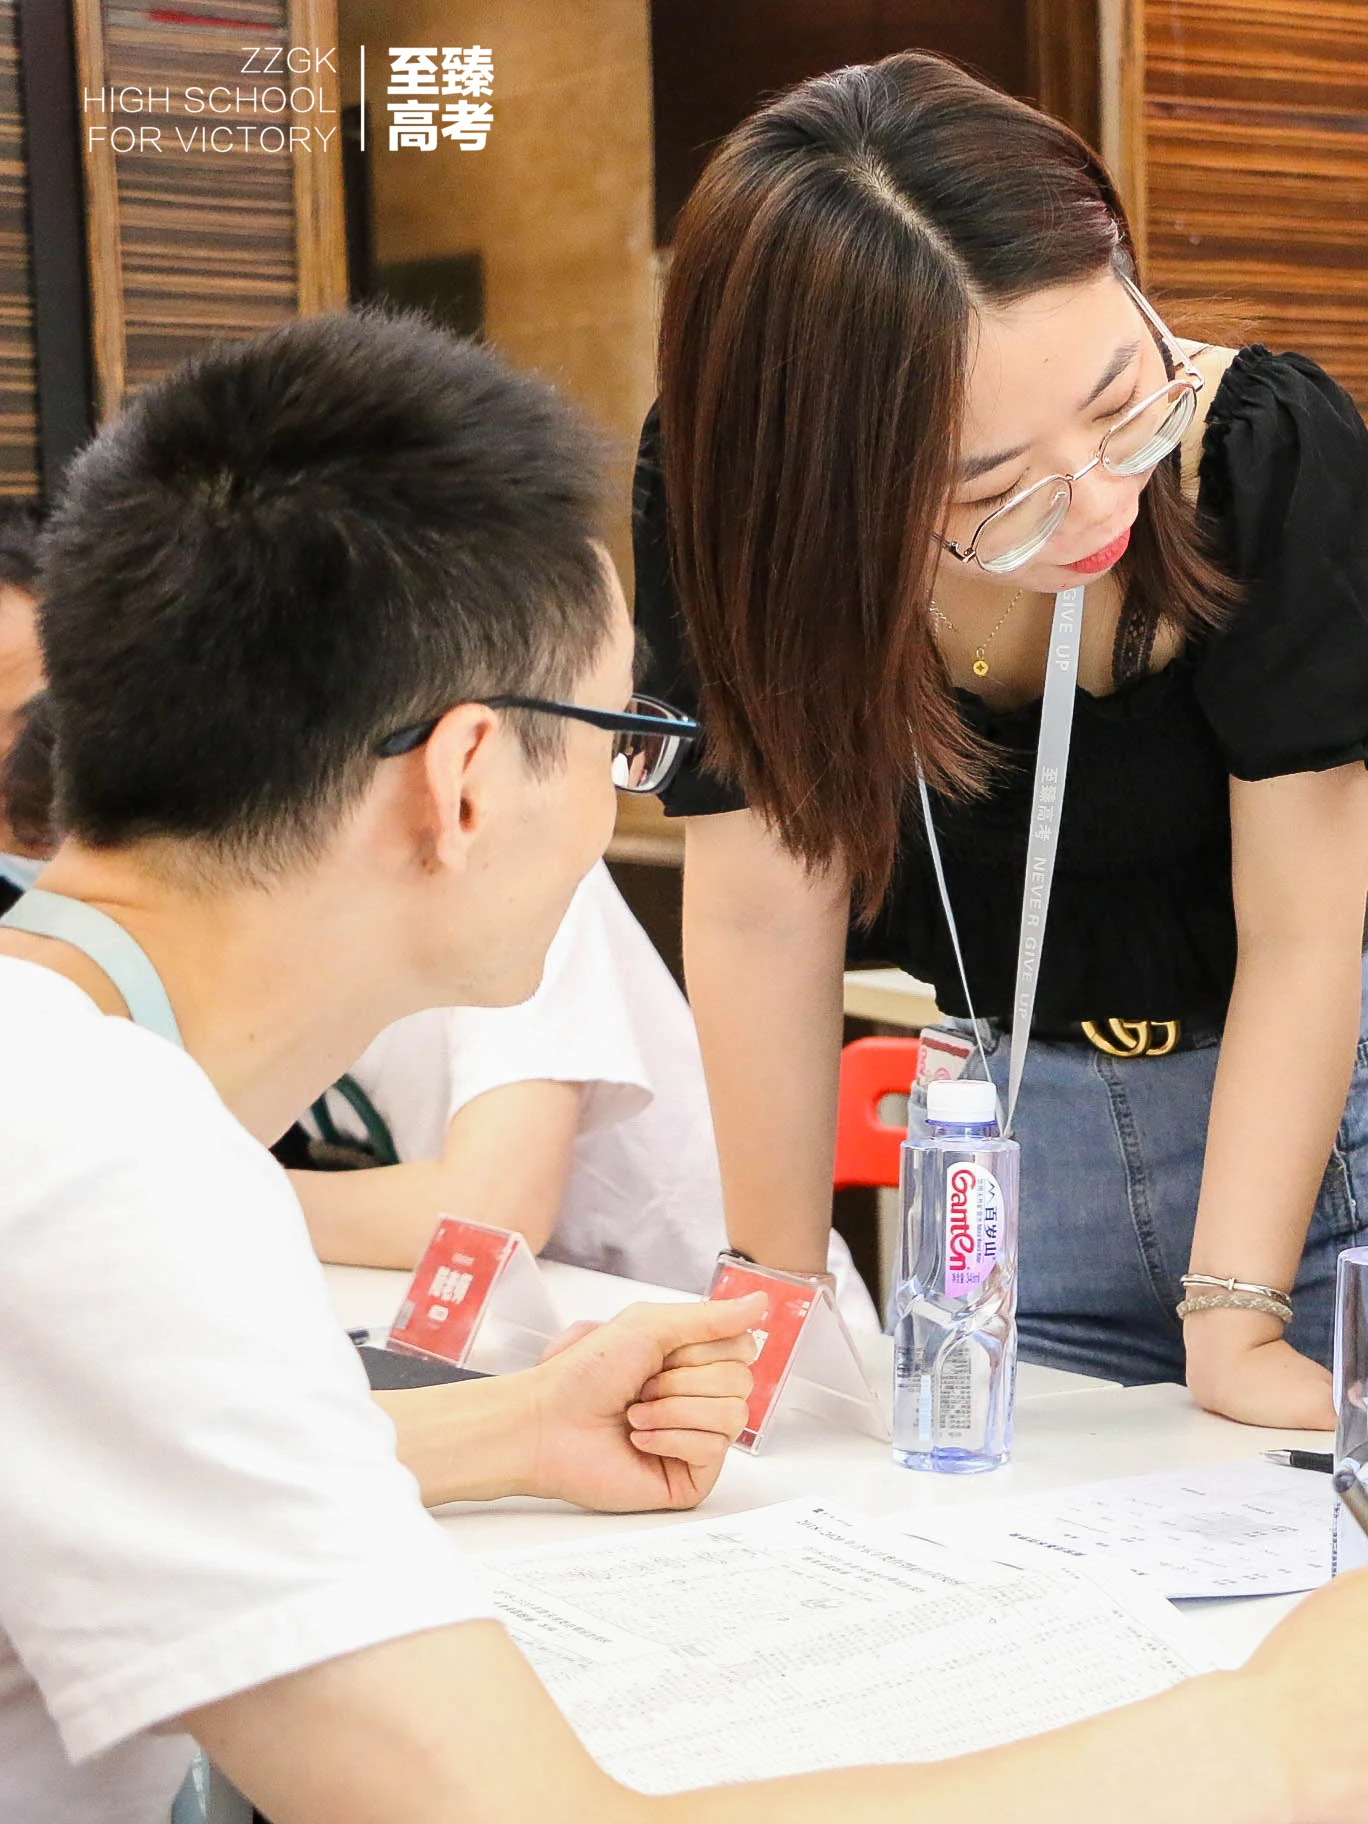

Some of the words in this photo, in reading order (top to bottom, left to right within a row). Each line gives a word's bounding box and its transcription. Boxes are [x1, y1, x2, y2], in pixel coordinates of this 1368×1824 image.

[1059, 588, 1077, 633] GIVE
[1055, 645, 1071, 671] UP
[1034, 766, 1058, 842] 至臻高考
[1027, 856, 1048, 927] NEVER
[1021, 936, 1037, 983] GIVE
[1018, 992, 1029, 1020] UP
[984, 1207, 998, 1257] 百岁山
